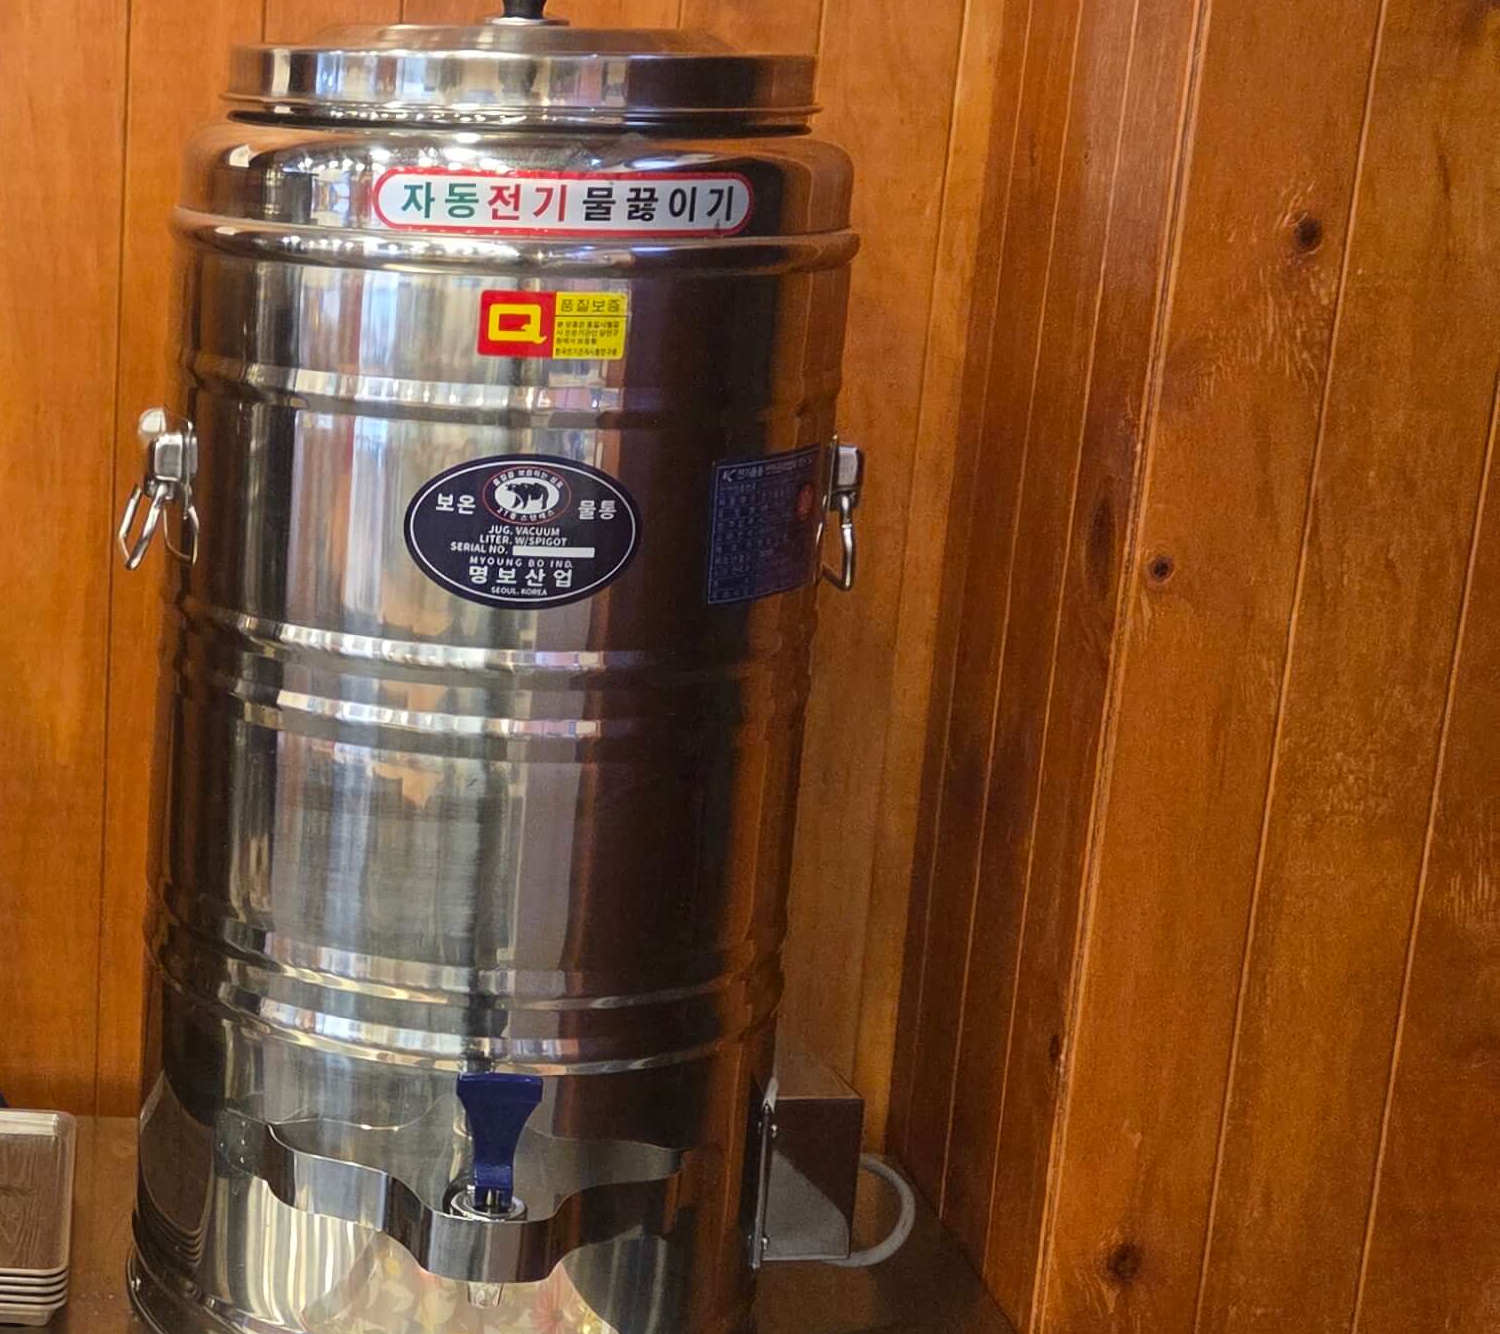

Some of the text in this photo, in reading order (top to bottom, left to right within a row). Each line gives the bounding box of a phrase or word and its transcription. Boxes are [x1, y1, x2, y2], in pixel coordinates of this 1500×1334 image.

[561, 299, 620, 312] 품질보증
[488, 303, 547, 344] Q
[435, 493, 476, 515] 보온
[578, 499, 617, 520] 물통
[488, 526, 560, 536] JUG. VACUUM
[479, 534, 568, 547] LITER. W/SPIGOT
[450, 542, 508, 555] SERIAL NO.
[469, 556, 523, 567] MYOUNG
[527, 558, 545, 567] BO
[469, 566, 572, 588] 명보산업
[521, 588, 548, 596] KOREA
